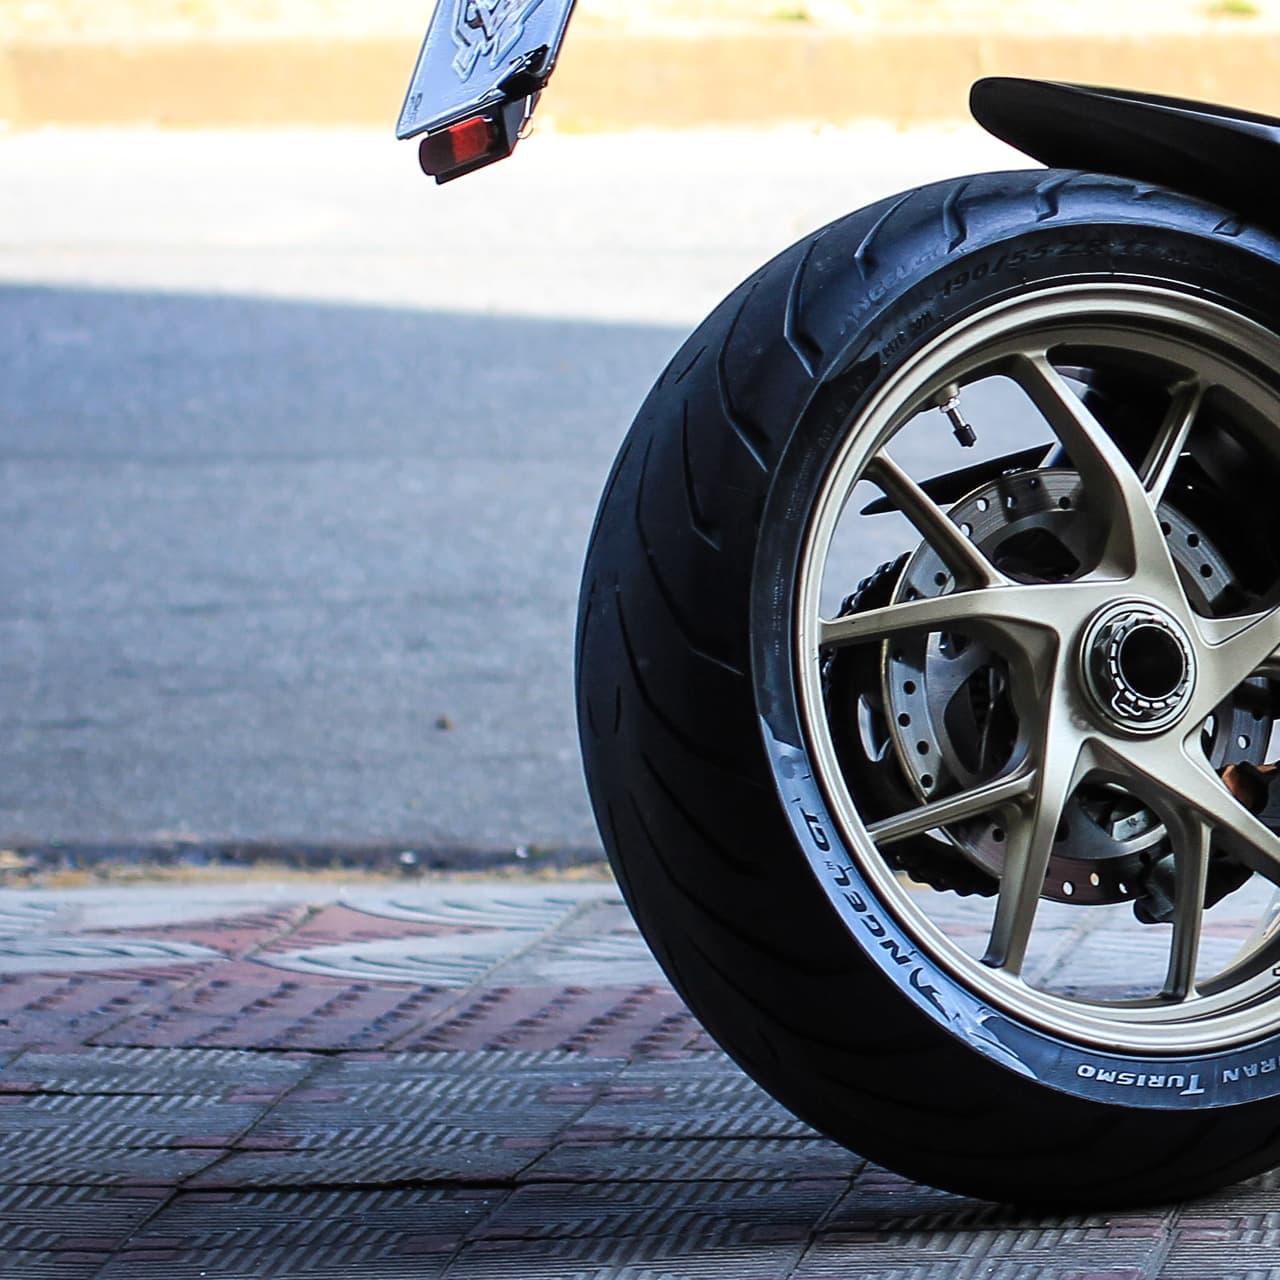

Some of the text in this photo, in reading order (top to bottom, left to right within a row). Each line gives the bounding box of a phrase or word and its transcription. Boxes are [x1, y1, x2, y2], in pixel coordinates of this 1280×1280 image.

[800, 807, 831, 852] GT
[833, 864, 951, 1022] ANGEL
[1076, 1064, 1205, 1096] TURISMO
